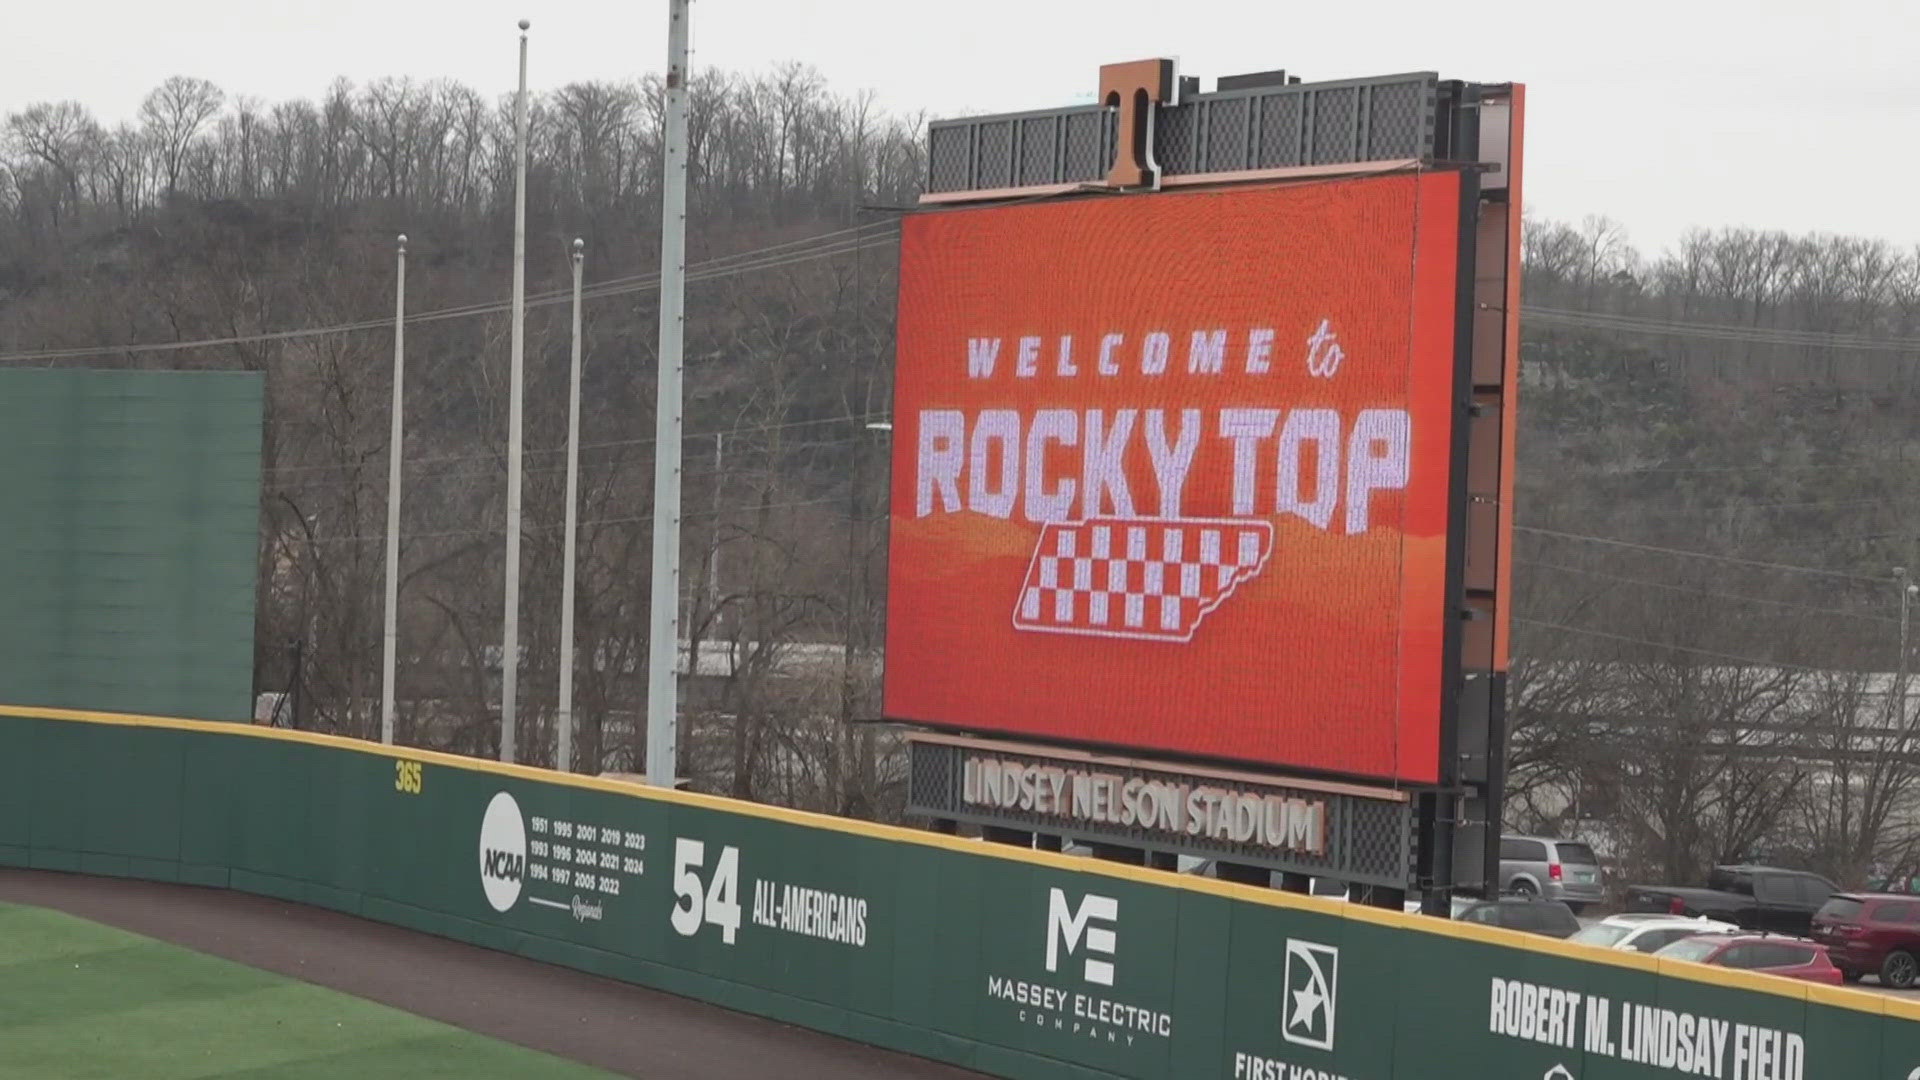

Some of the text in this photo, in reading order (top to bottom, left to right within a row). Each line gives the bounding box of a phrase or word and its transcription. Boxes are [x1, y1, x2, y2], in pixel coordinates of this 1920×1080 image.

[1100, 58, 1166, 187] T
[967, 319, 1344, 379] WELCOME to
[916, 408, 1411, 535] ROCKY TOP
[395, 760, 422, 795] 365
[963, 757, 1324, 855] LINDSEY NELSON STADIUM
[530, 840, 644, 875] 1993 1996 2004 2021 2024
[531, 816, 646, 851] 1951 1995 2001 2019 2023
[484, 848, 524, 884] NCAA
[530, 863, 620, 895] 1994 1997 2005 2022
[670, 836, 742, 945] 54
[571, 894, 603, 923] Regionals
[752, 878, 867, 947] ALL-AMERICANS
[988, 975, 1171, 1037] MASSEY ELECTRIC
[1019, 1009, 1134, 1047] COMPANY
[1490, 977, 1804, 1080] ROBERT M. LINDSAY FIELD
[1235, 1052, 1286, 1080] FIRST
